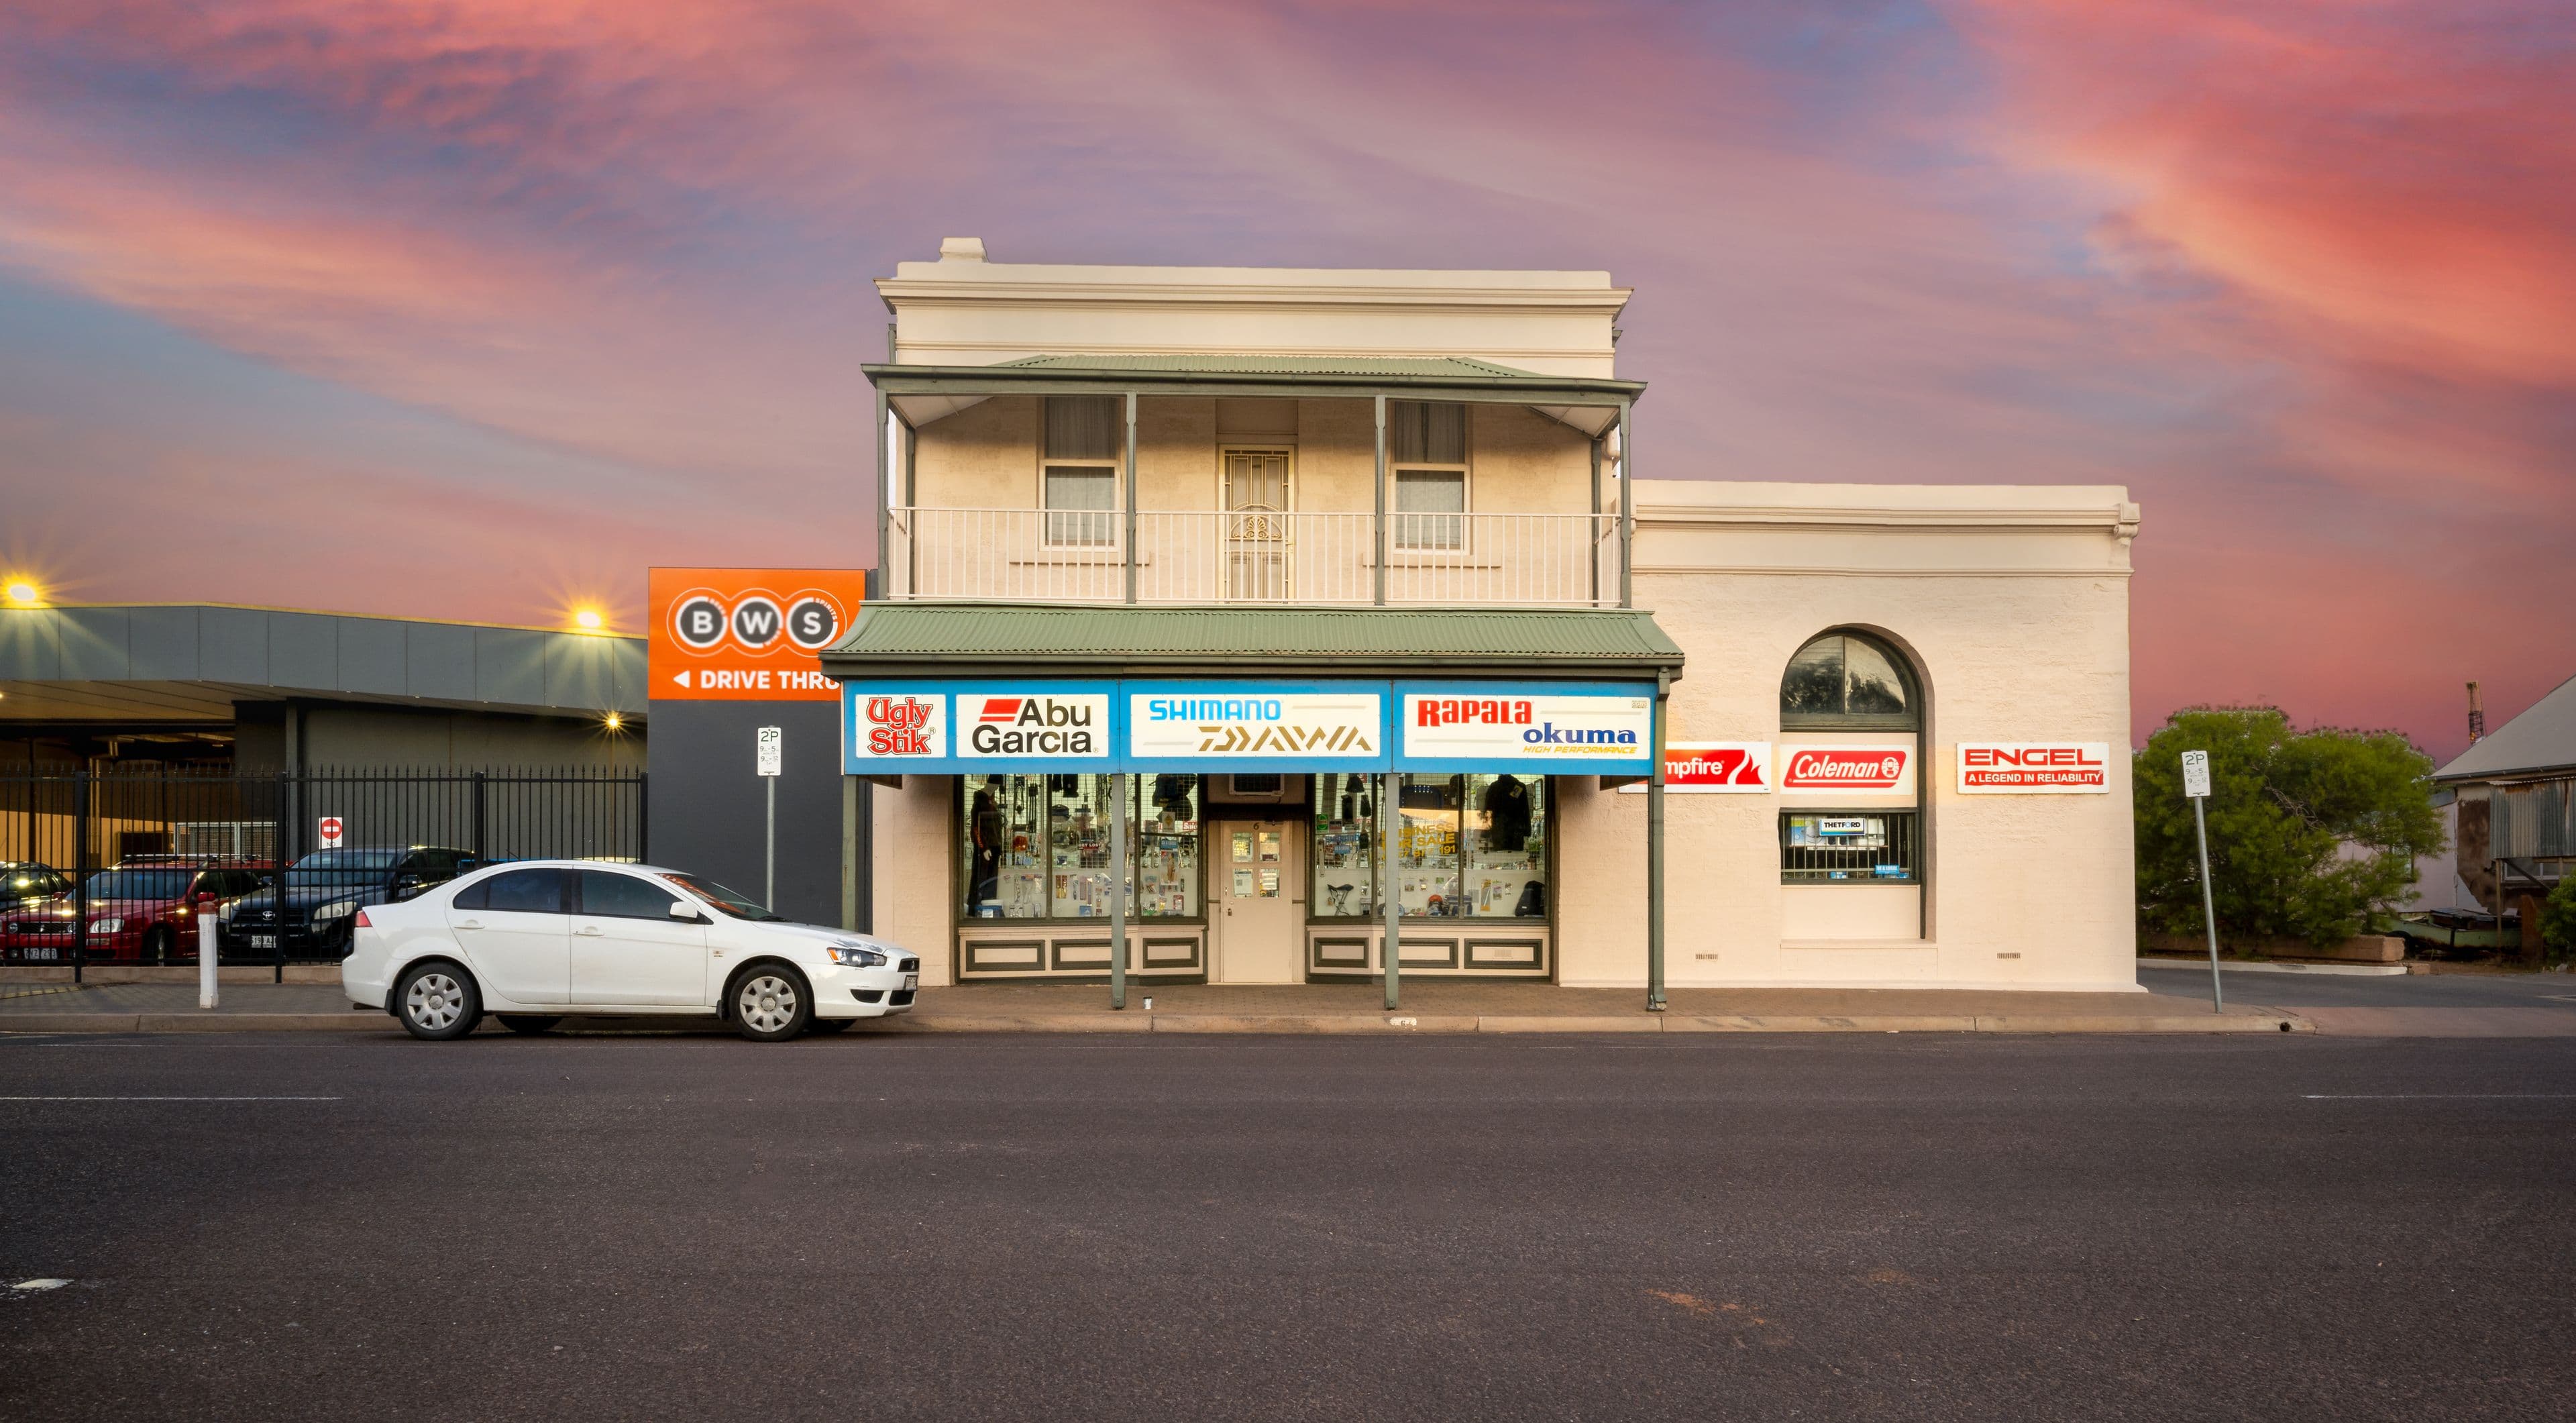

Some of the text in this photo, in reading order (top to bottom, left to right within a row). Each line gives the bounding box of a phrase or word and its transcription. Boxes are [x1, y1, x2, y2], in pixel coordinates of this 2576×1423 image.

[815, 597, 838, 620] SPIRITS
[700, 670, 771, 690] DRIVE
[866, 697, 934, 729] Ugly
[1017, 698, 1091, 727] Abu
[1149, 699, 1281, 721] SHIMANO
[761, 731, 778, 741] 2P
[868, 728, 932, 755] Stik
[972, 725, 1091, 753] Garcia
[1198, 725, 1373, 751] DAIWA
[1523, 722, 1639, 743] okuma
[1523, 745, 1638, 754] HIGH PERFORMANCE
[1964, 749, 2102, 766] ENGEL
[2185, 754, 2204, 765] 2P
[1664, 757, 1723, 779] mpfire
[1794, 754, 1879, 778] Coleman
[1968, 773, 2100, 782] A LEGEND IN RELIABILITY
[1416, 831, 1455, 847] SALE
